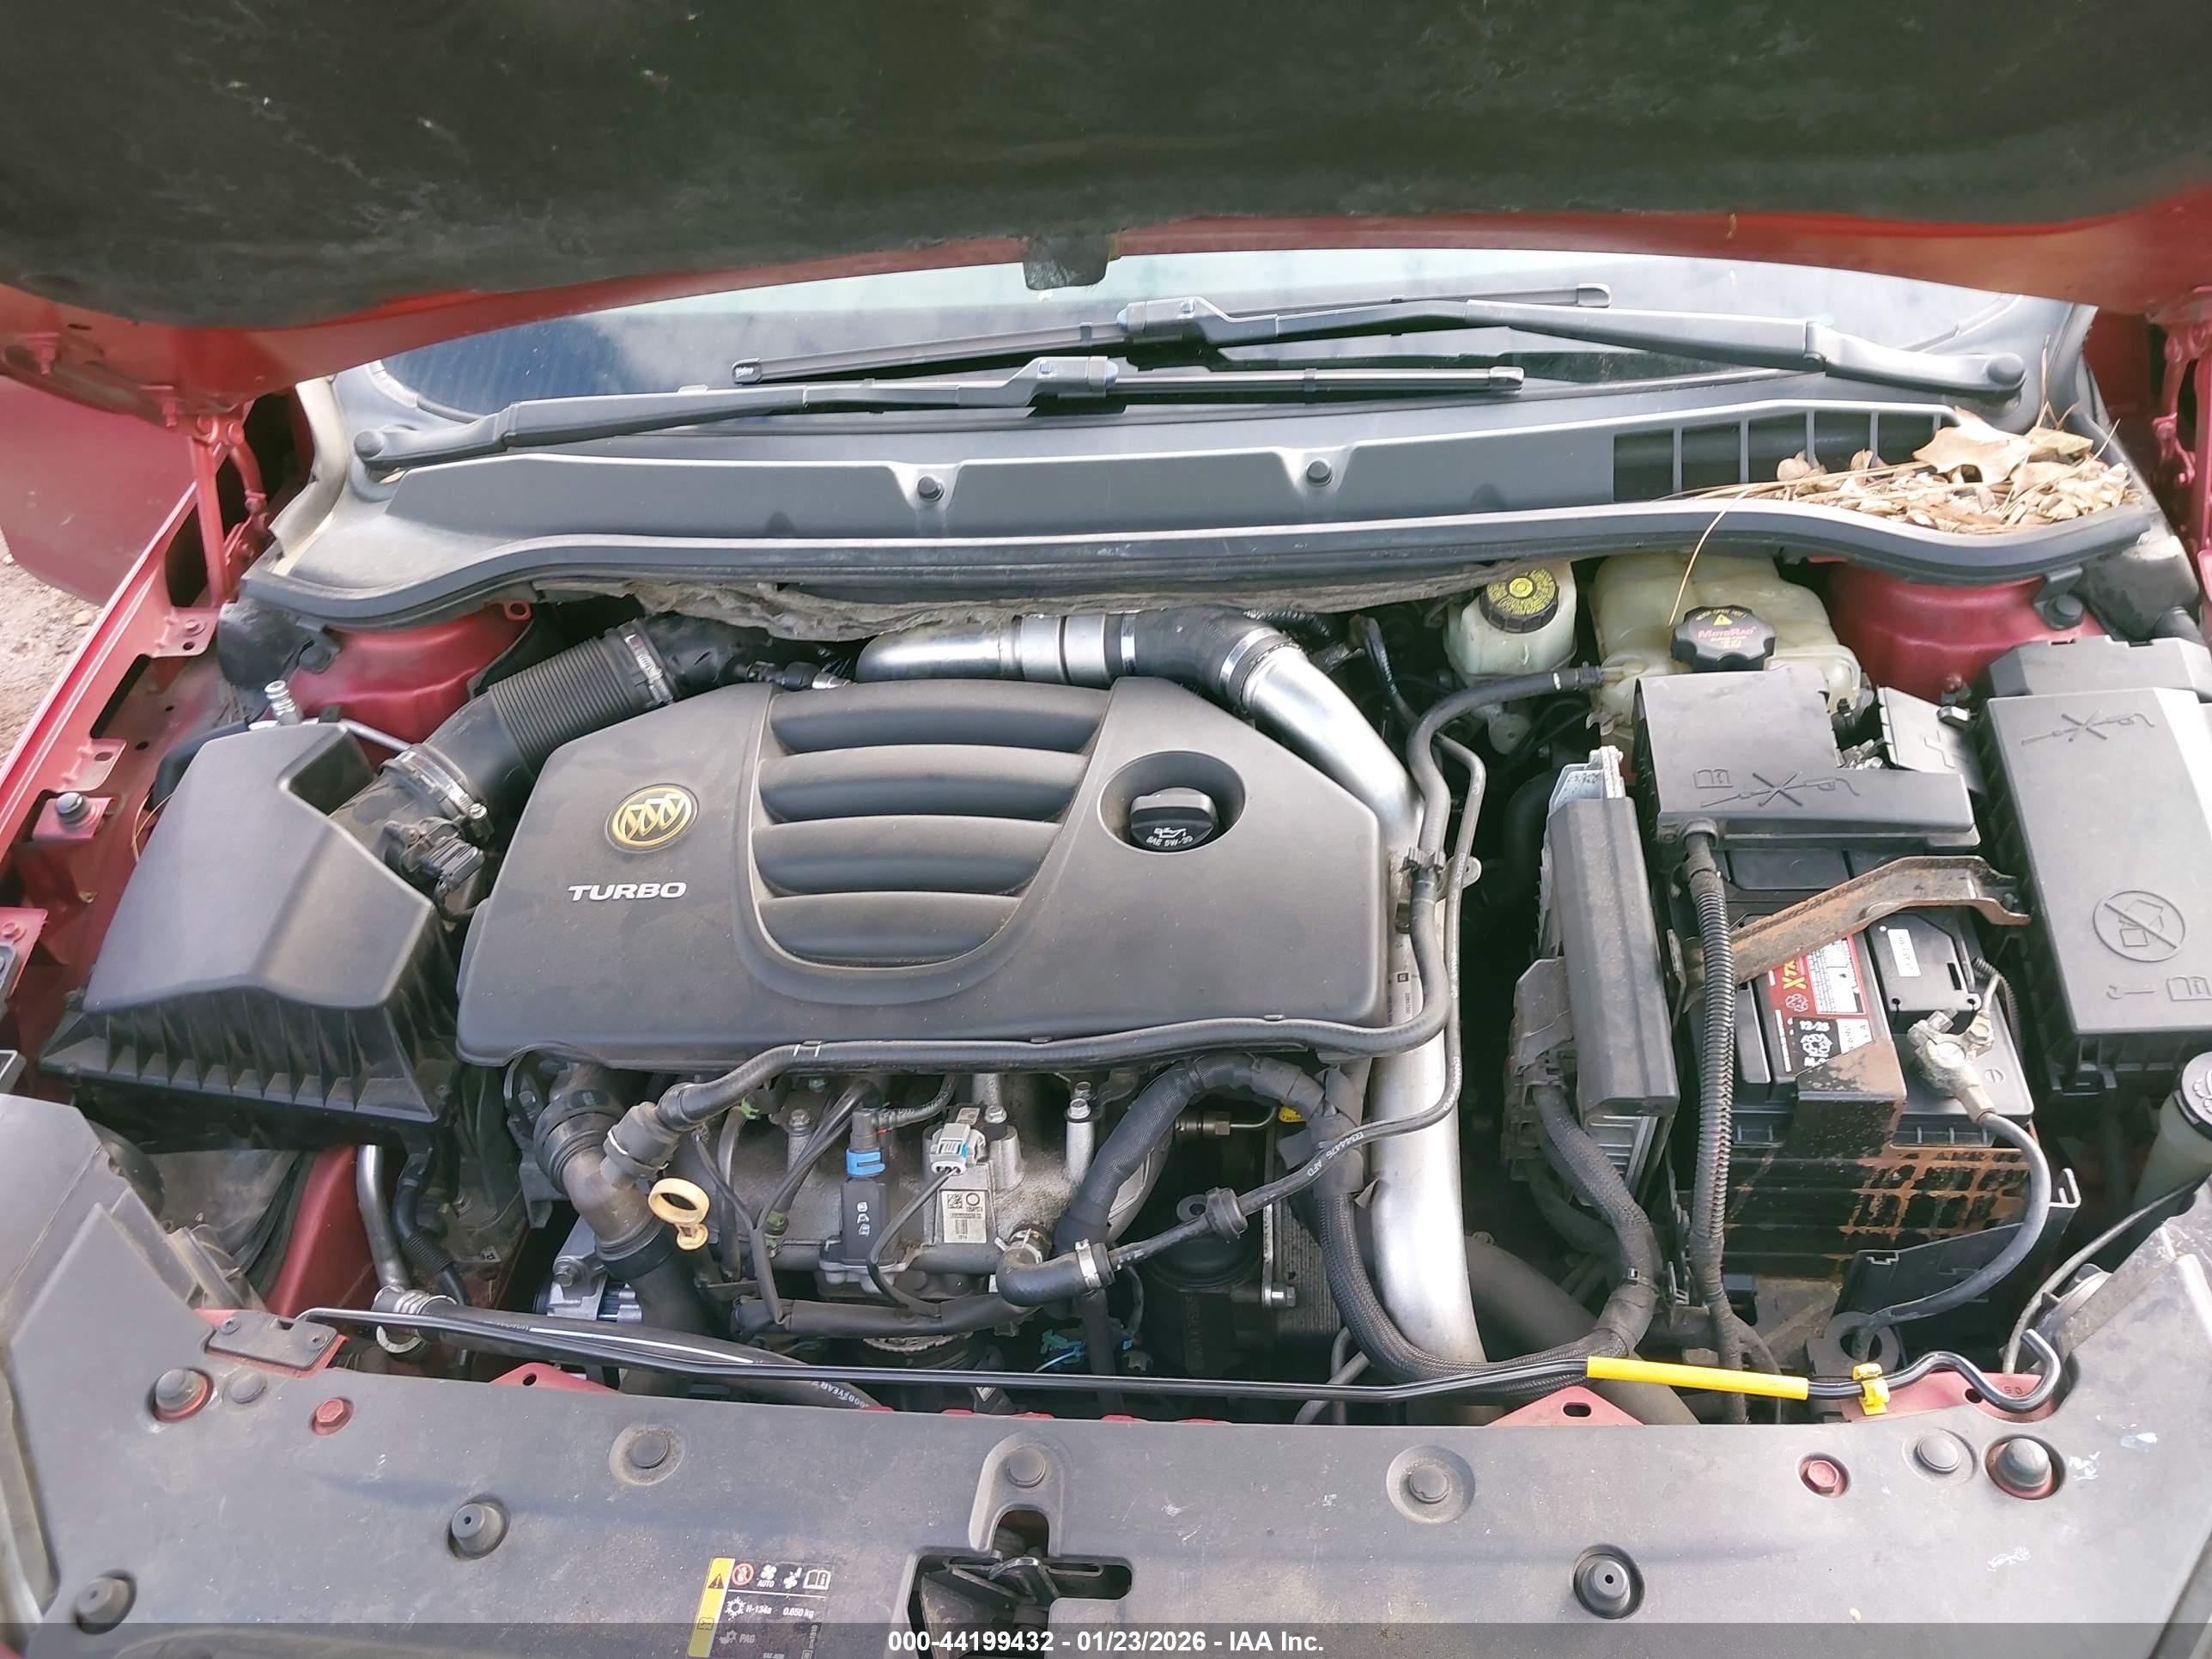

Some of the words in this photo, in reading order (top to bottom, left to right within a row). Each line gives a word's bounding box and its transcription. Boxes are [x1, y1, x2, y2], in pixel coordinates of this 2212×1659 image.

[568, 882, 687, 902] TURBO
[757, 1579, 775, 1589] AUTO
[805, 1609, 815, 1620] kg
[739, 1633, 756, 1644] PAG
